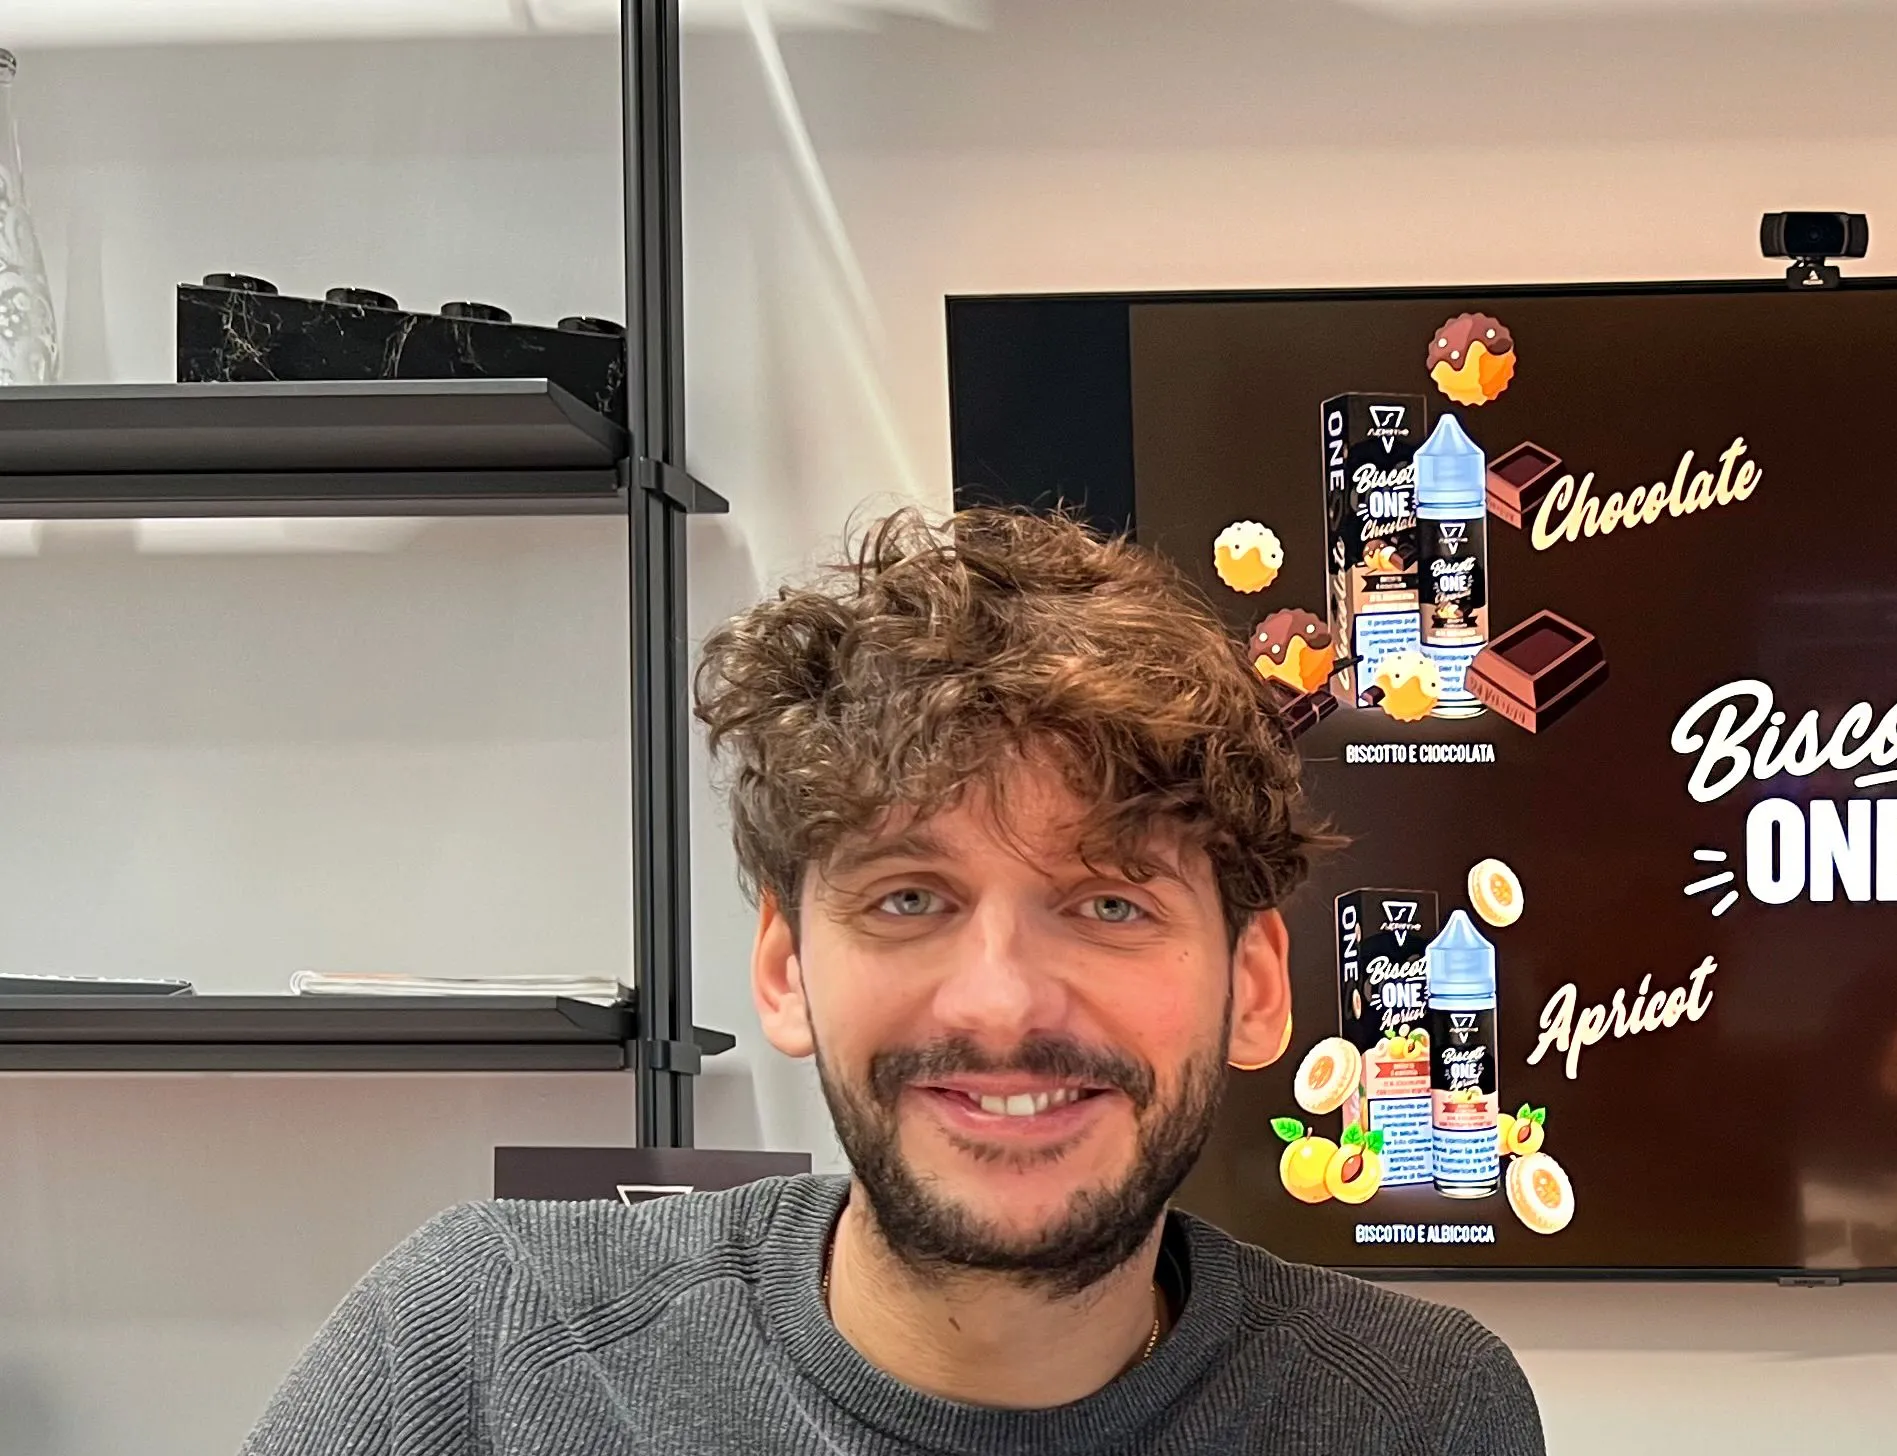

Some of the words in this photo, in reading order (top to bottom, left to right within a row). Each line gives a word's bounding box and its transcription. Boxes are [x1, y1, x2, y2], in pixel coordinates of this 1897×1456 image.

[1328, 410, 1345, 491] ONE
[1369, 491, 1410, 518] ONE
[1530, 436, 1763, 552] Chocolate
[1345, 744, 1407, 763] BISCOTTO
[1409, 744, 1418, 763] E
[1419, 744, 1496, 763] CIOCCOLATA
[1342, 905, 1358, 982] ONE
[1382, 982, 1422, 1008] ONE
[1527, 956, 1718, 1080] Apricot
[1355, 1225, 1415, 1243] BISCOTTO
[1418, 1225, 1426, 1243] E
[1427, 1225, 1495, 1243] ALBICOCCA
